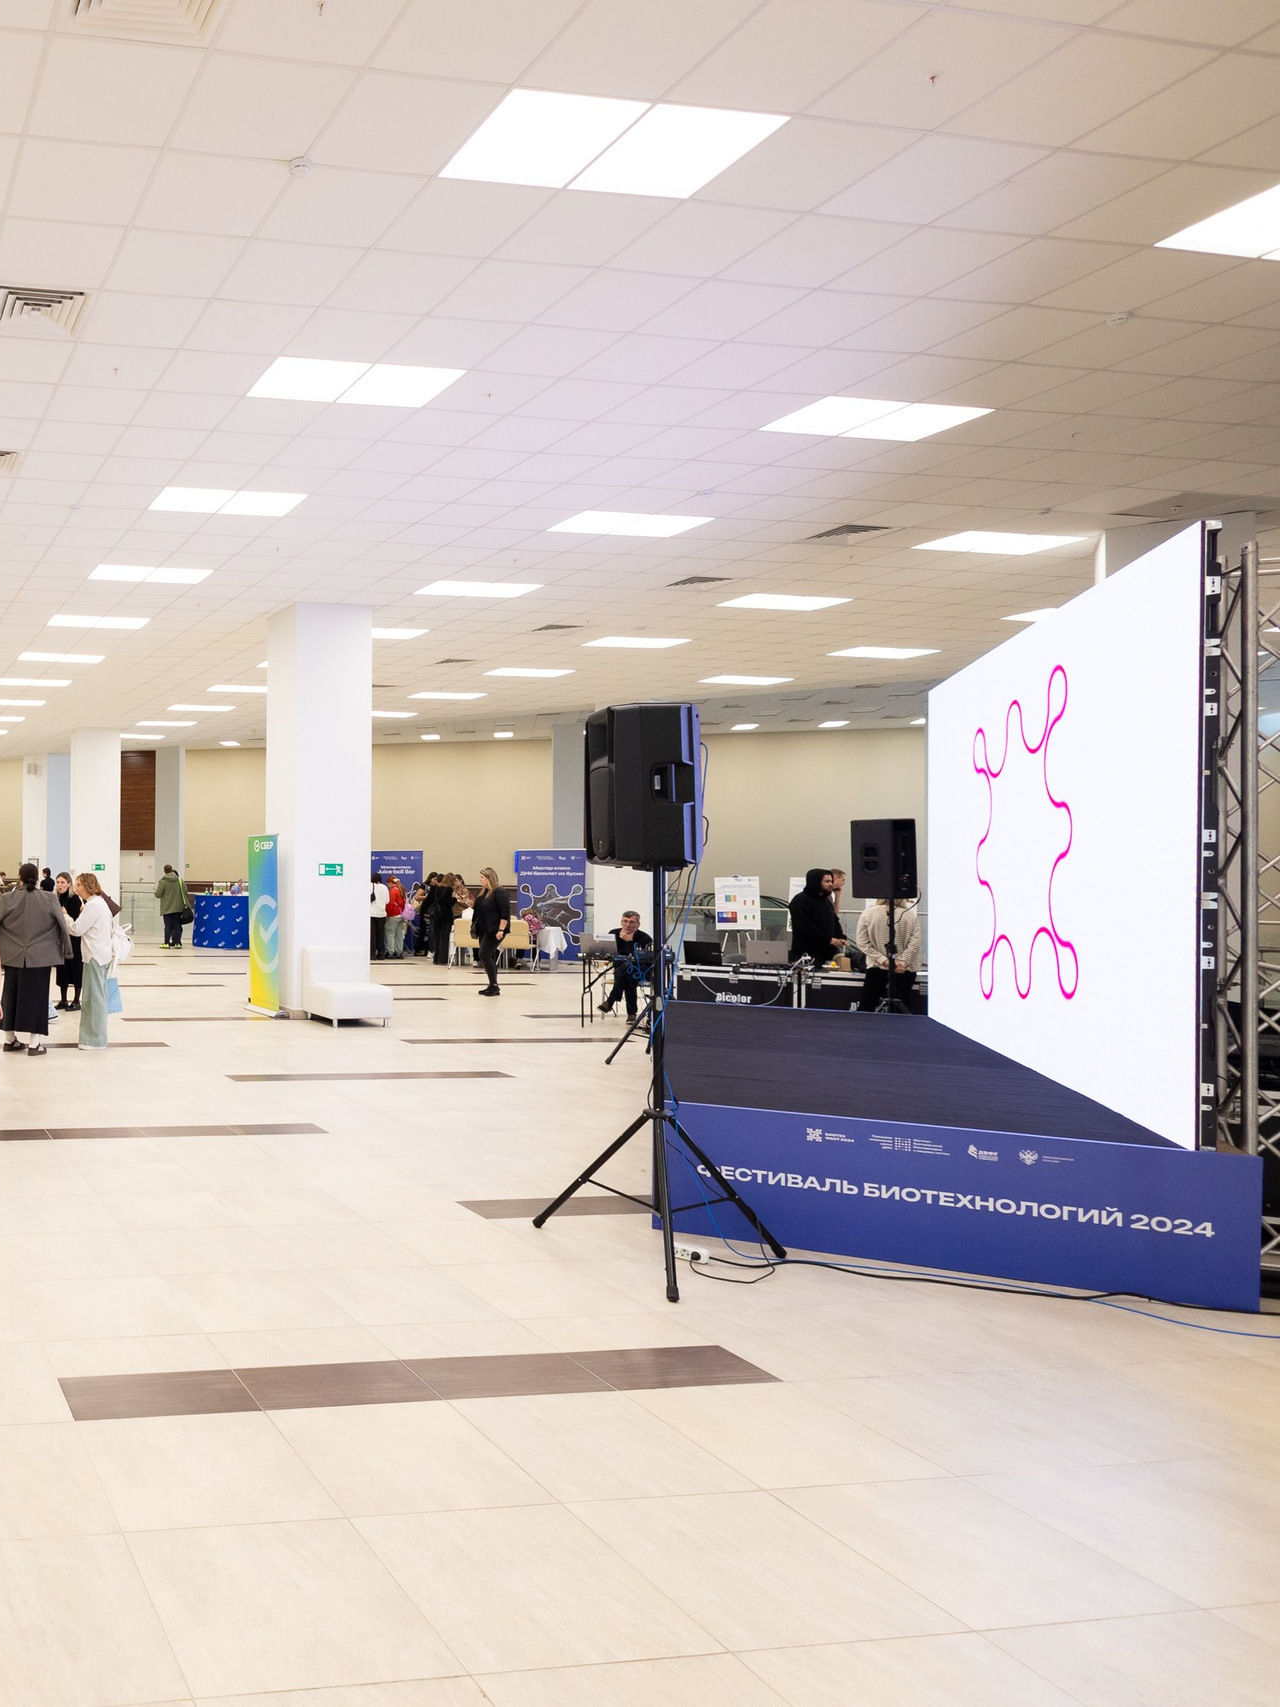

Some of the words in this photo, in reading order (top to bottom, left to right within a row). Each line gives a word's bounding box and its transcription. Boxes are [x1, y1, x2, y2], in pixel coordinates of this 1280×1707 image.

[261, 841, 274, 850] СБЕР
[863, 1182, 1123, 1227] БИОТЕХНОЛОГИЙ
[1129, 1213, 1215, 1238] 2024
